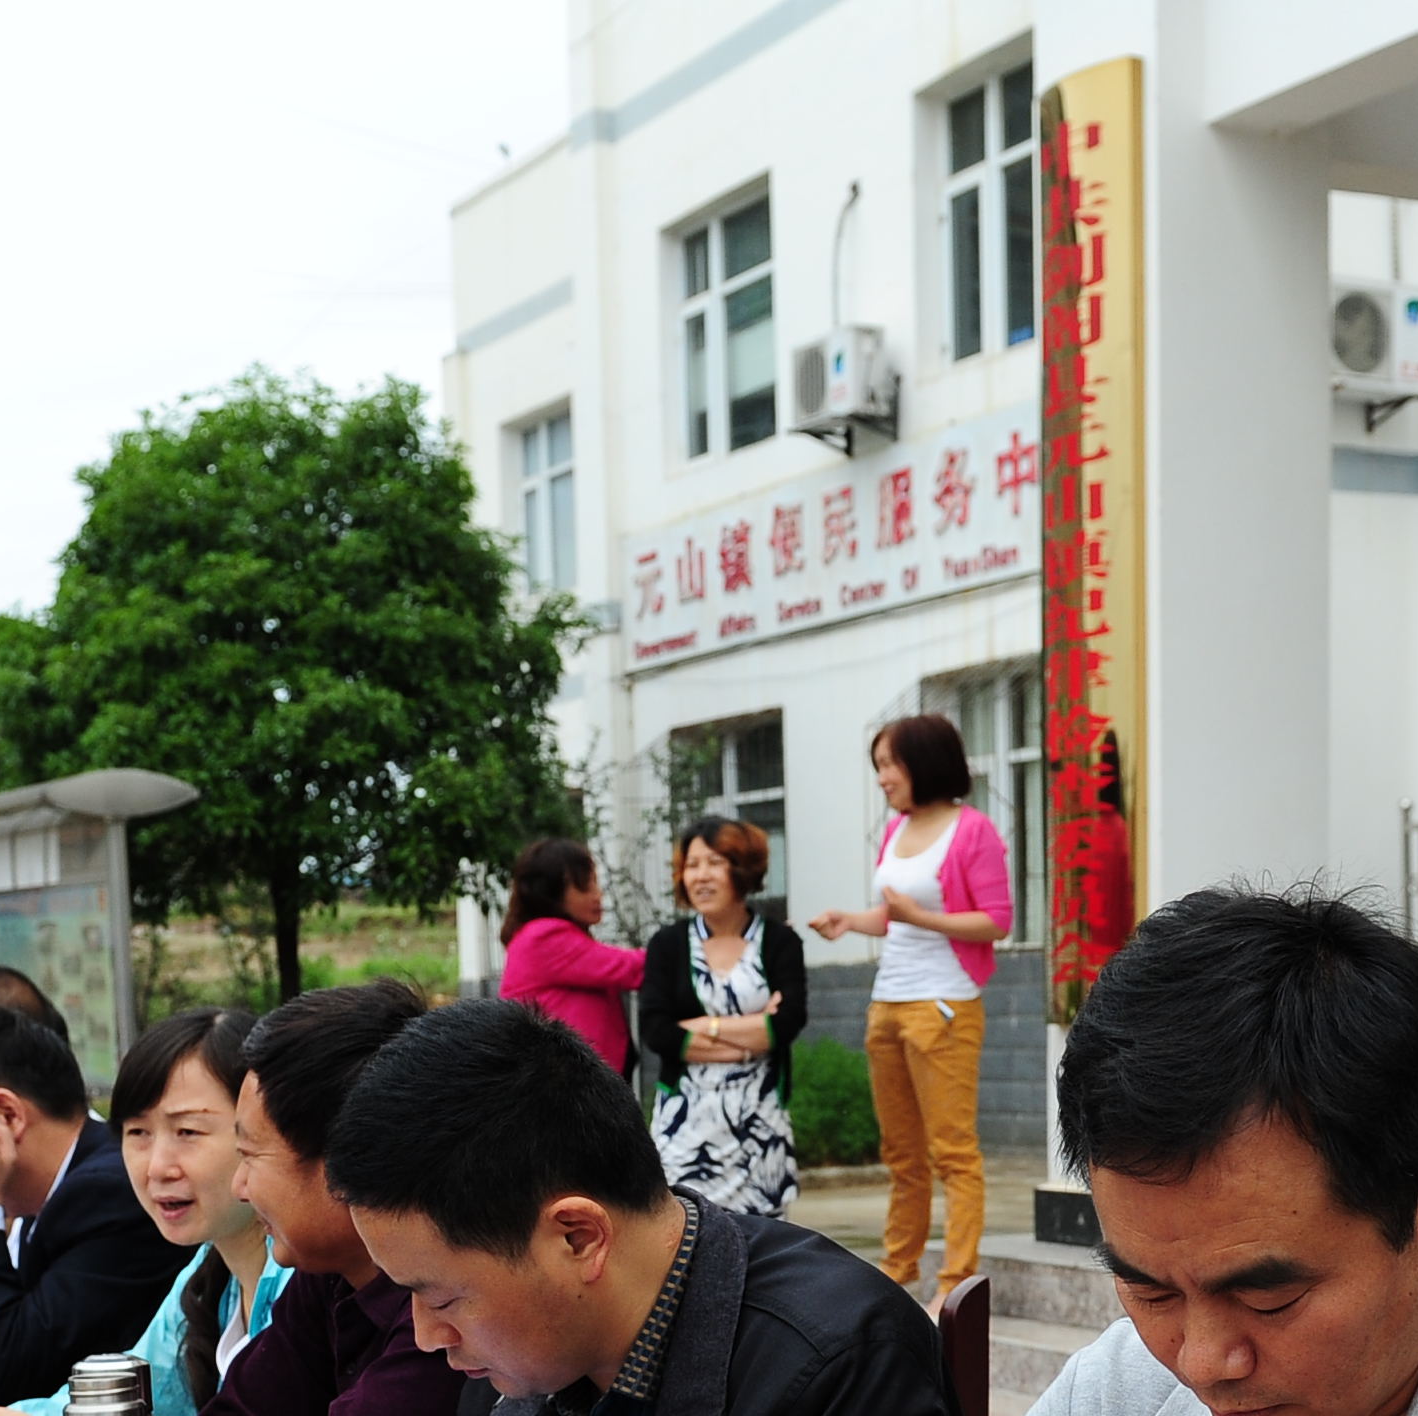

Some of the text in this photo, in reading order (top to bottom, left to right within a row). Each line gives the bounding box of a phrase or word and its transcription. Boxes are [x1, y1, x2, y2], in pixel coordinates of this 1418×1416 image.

[633, 430, 1040, 620] 元山镇便民服务中
